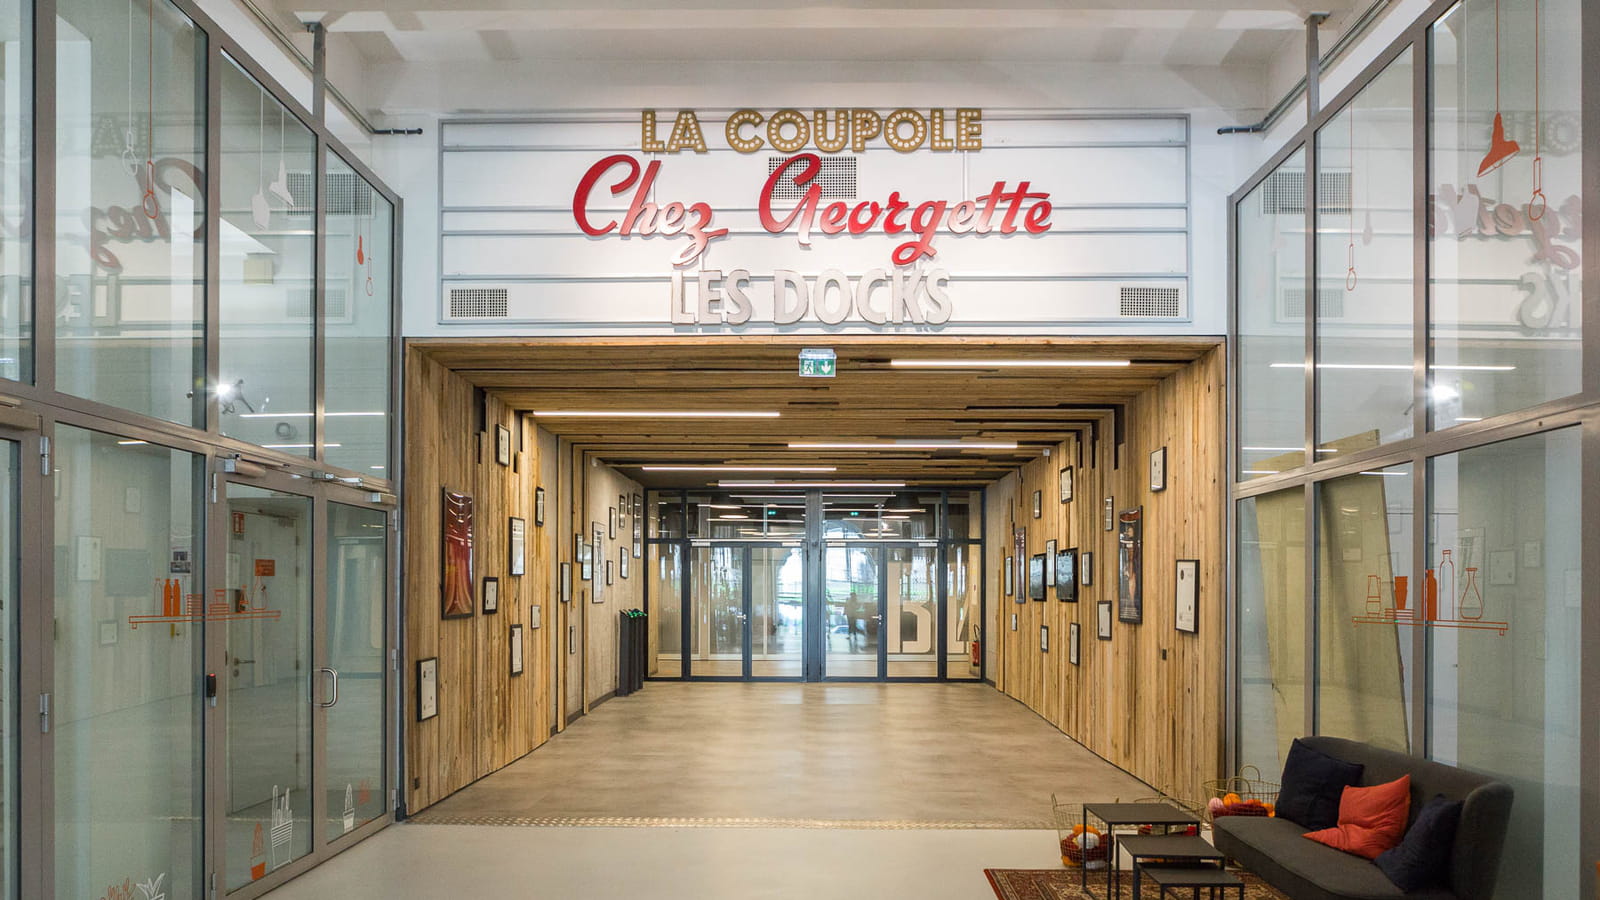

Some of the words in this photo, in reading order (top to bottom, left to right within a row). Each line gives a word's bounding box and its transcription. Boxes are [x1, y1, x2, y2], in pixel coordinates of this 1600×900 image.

[642, 108, 708, 153] LA
[725, 108, 983, 153] COUPOLE
[572, 154, 728, 266] Chez
[758, 153, 1053, 265] Georgette
[671, 269, 752, 325] LES
[773, 268, 953, 325] DOCKS
